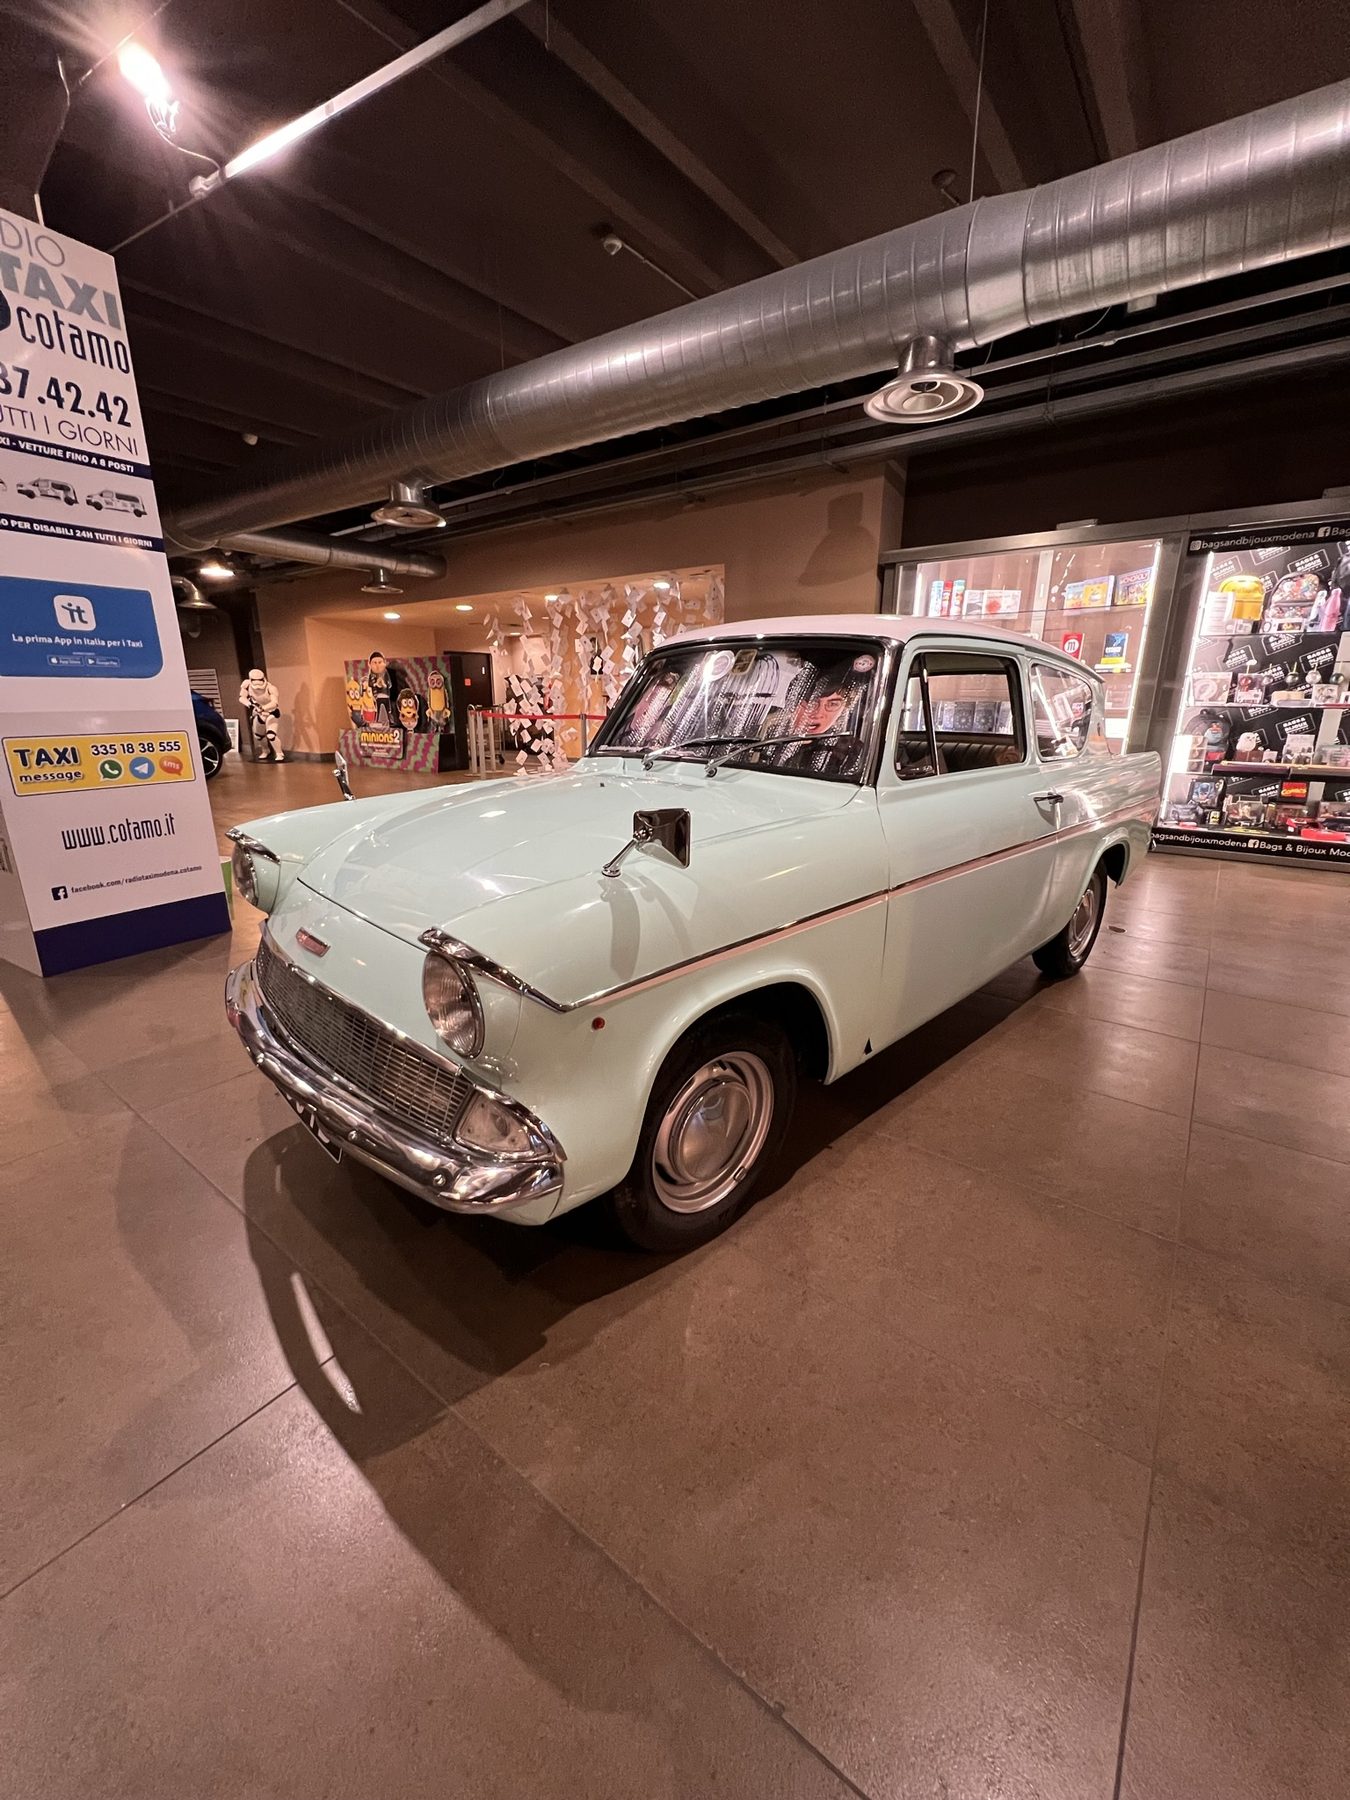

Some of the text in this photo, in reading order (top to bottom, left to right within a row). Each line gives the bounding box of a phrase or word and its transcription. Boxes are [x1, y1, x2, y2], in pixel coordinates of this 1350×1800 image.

[0, 217, 65, 267] DIO
[0, 251, 121, 331] TAXI
[16, 306, 130, 374] cotamo
[0, 404, 138, 456] TTI I GIORNI
[18, 440, 64, 458] VETTURE
[66, 451, 89, 464] FINO
[91, 457, 98, 465] A
[100, 459, 106, 467] 8
[108, 461, 134, 473] POSTI
[10, 519, 31, 530] PER
[33, 523, 74, 536] DISABILI
[75, 530, 94, 539] 24H
[94, 532, 117, 542] TUTTI
[123, 537, 153, 548] GIORNI
[1202, 531, 1315, 549] bagsandbijouxmodena
[12, 633, 23, 642] La
[25, 635, 52, 644] prima
[54, 636, 72, 646] App
[74, 637, 82, 645] in
[84, 638, 105, 646] Italia
[107, 640, 120, 648] per
[127, 640, 143, 648] Taxi
[13, 747, 80, 768] TAXI
[91, 741, 181, 756] 335 18 38 555
[19, 770, 82, 783] message
[163, 760, 180, 770] sms
[61, 813, 176, 850] www.cotamo.it
[1260, 841, 1282, 852] Bags
[1285, 843, 1293, 851] &
[1296, 844, 1327, 855] Bijoux
